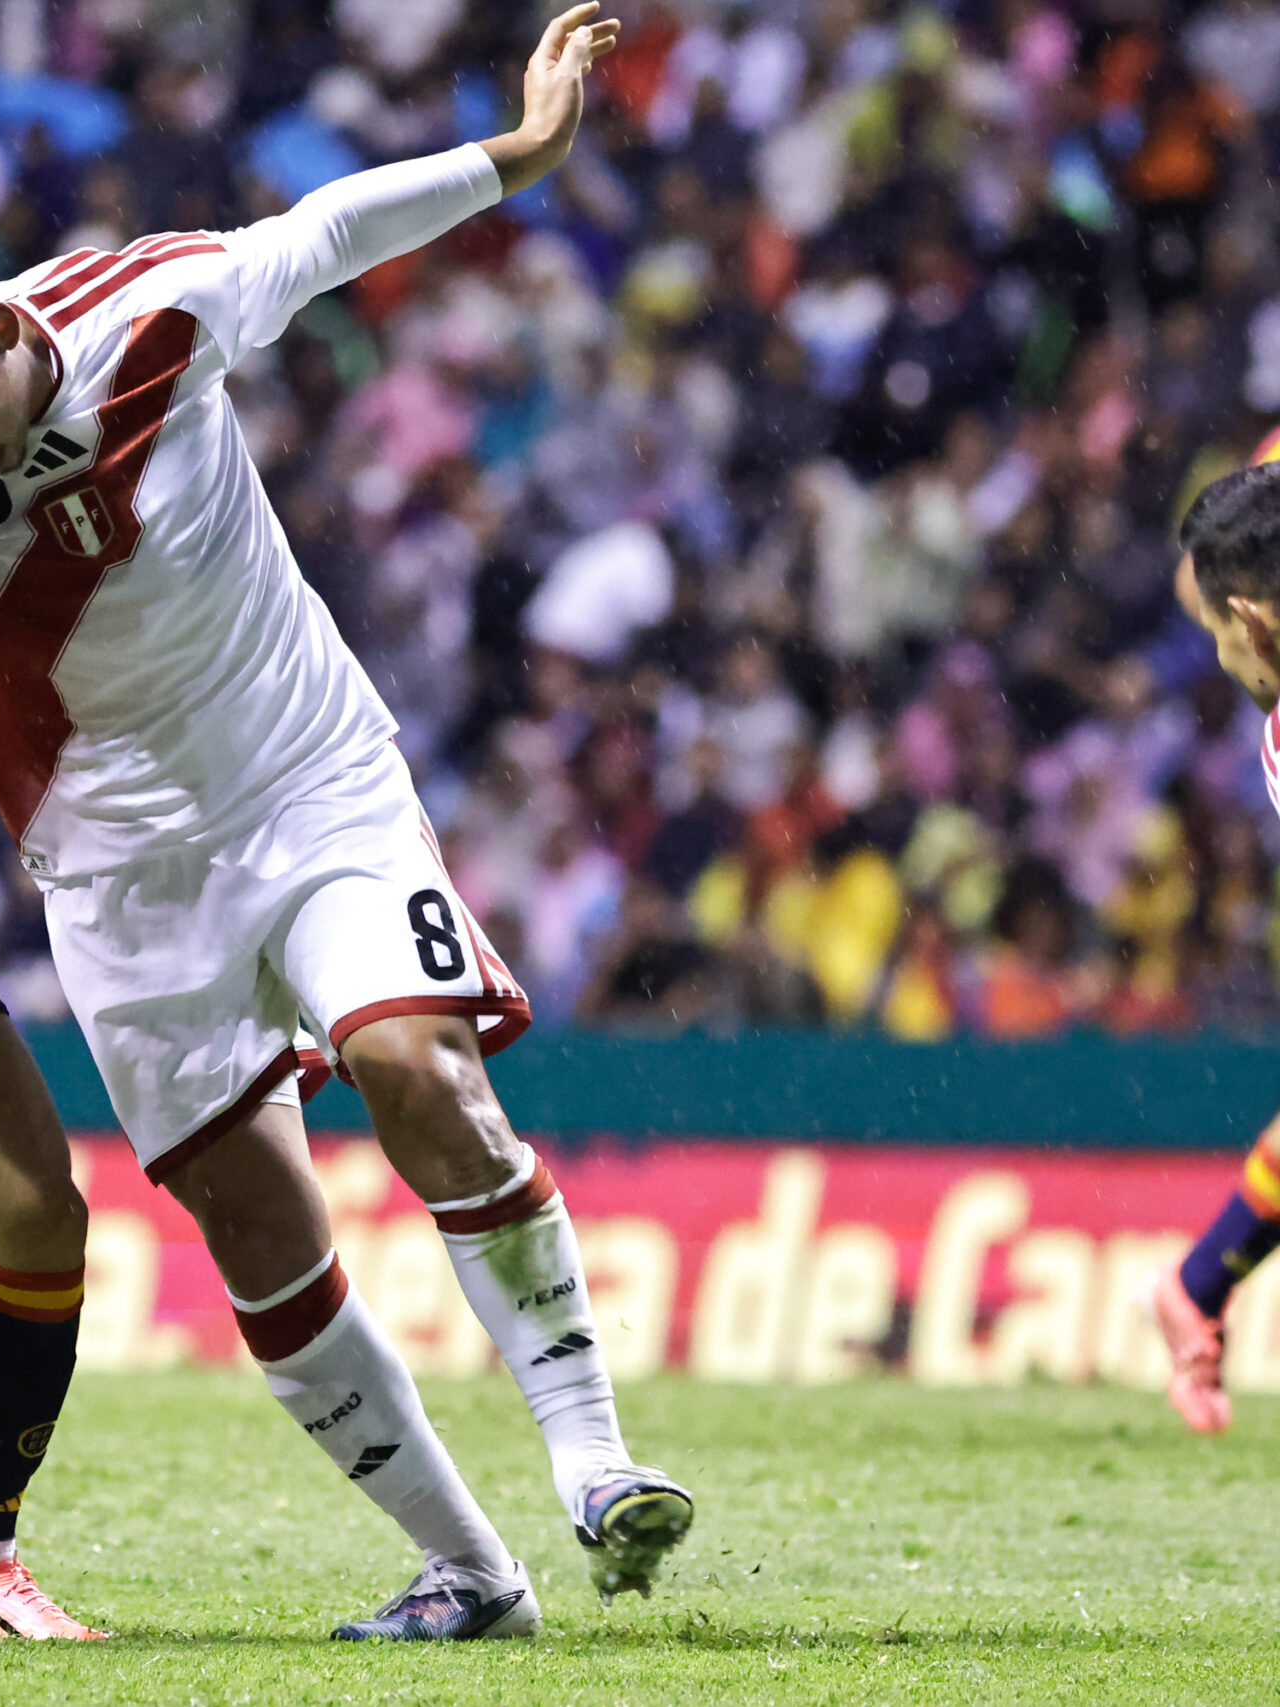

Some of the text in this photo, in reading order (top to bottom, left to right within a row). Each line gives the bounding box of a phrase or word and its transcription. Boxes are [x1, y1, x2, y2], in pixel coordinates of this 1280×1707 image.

[61, 508, 100, 534] FPF
[407, 889, 466, 981] 8
[690, 1147, 900, 1383] de
[517, 1276, 576, 1311] PERU
[304, 1391, 362, 1434] PERU
